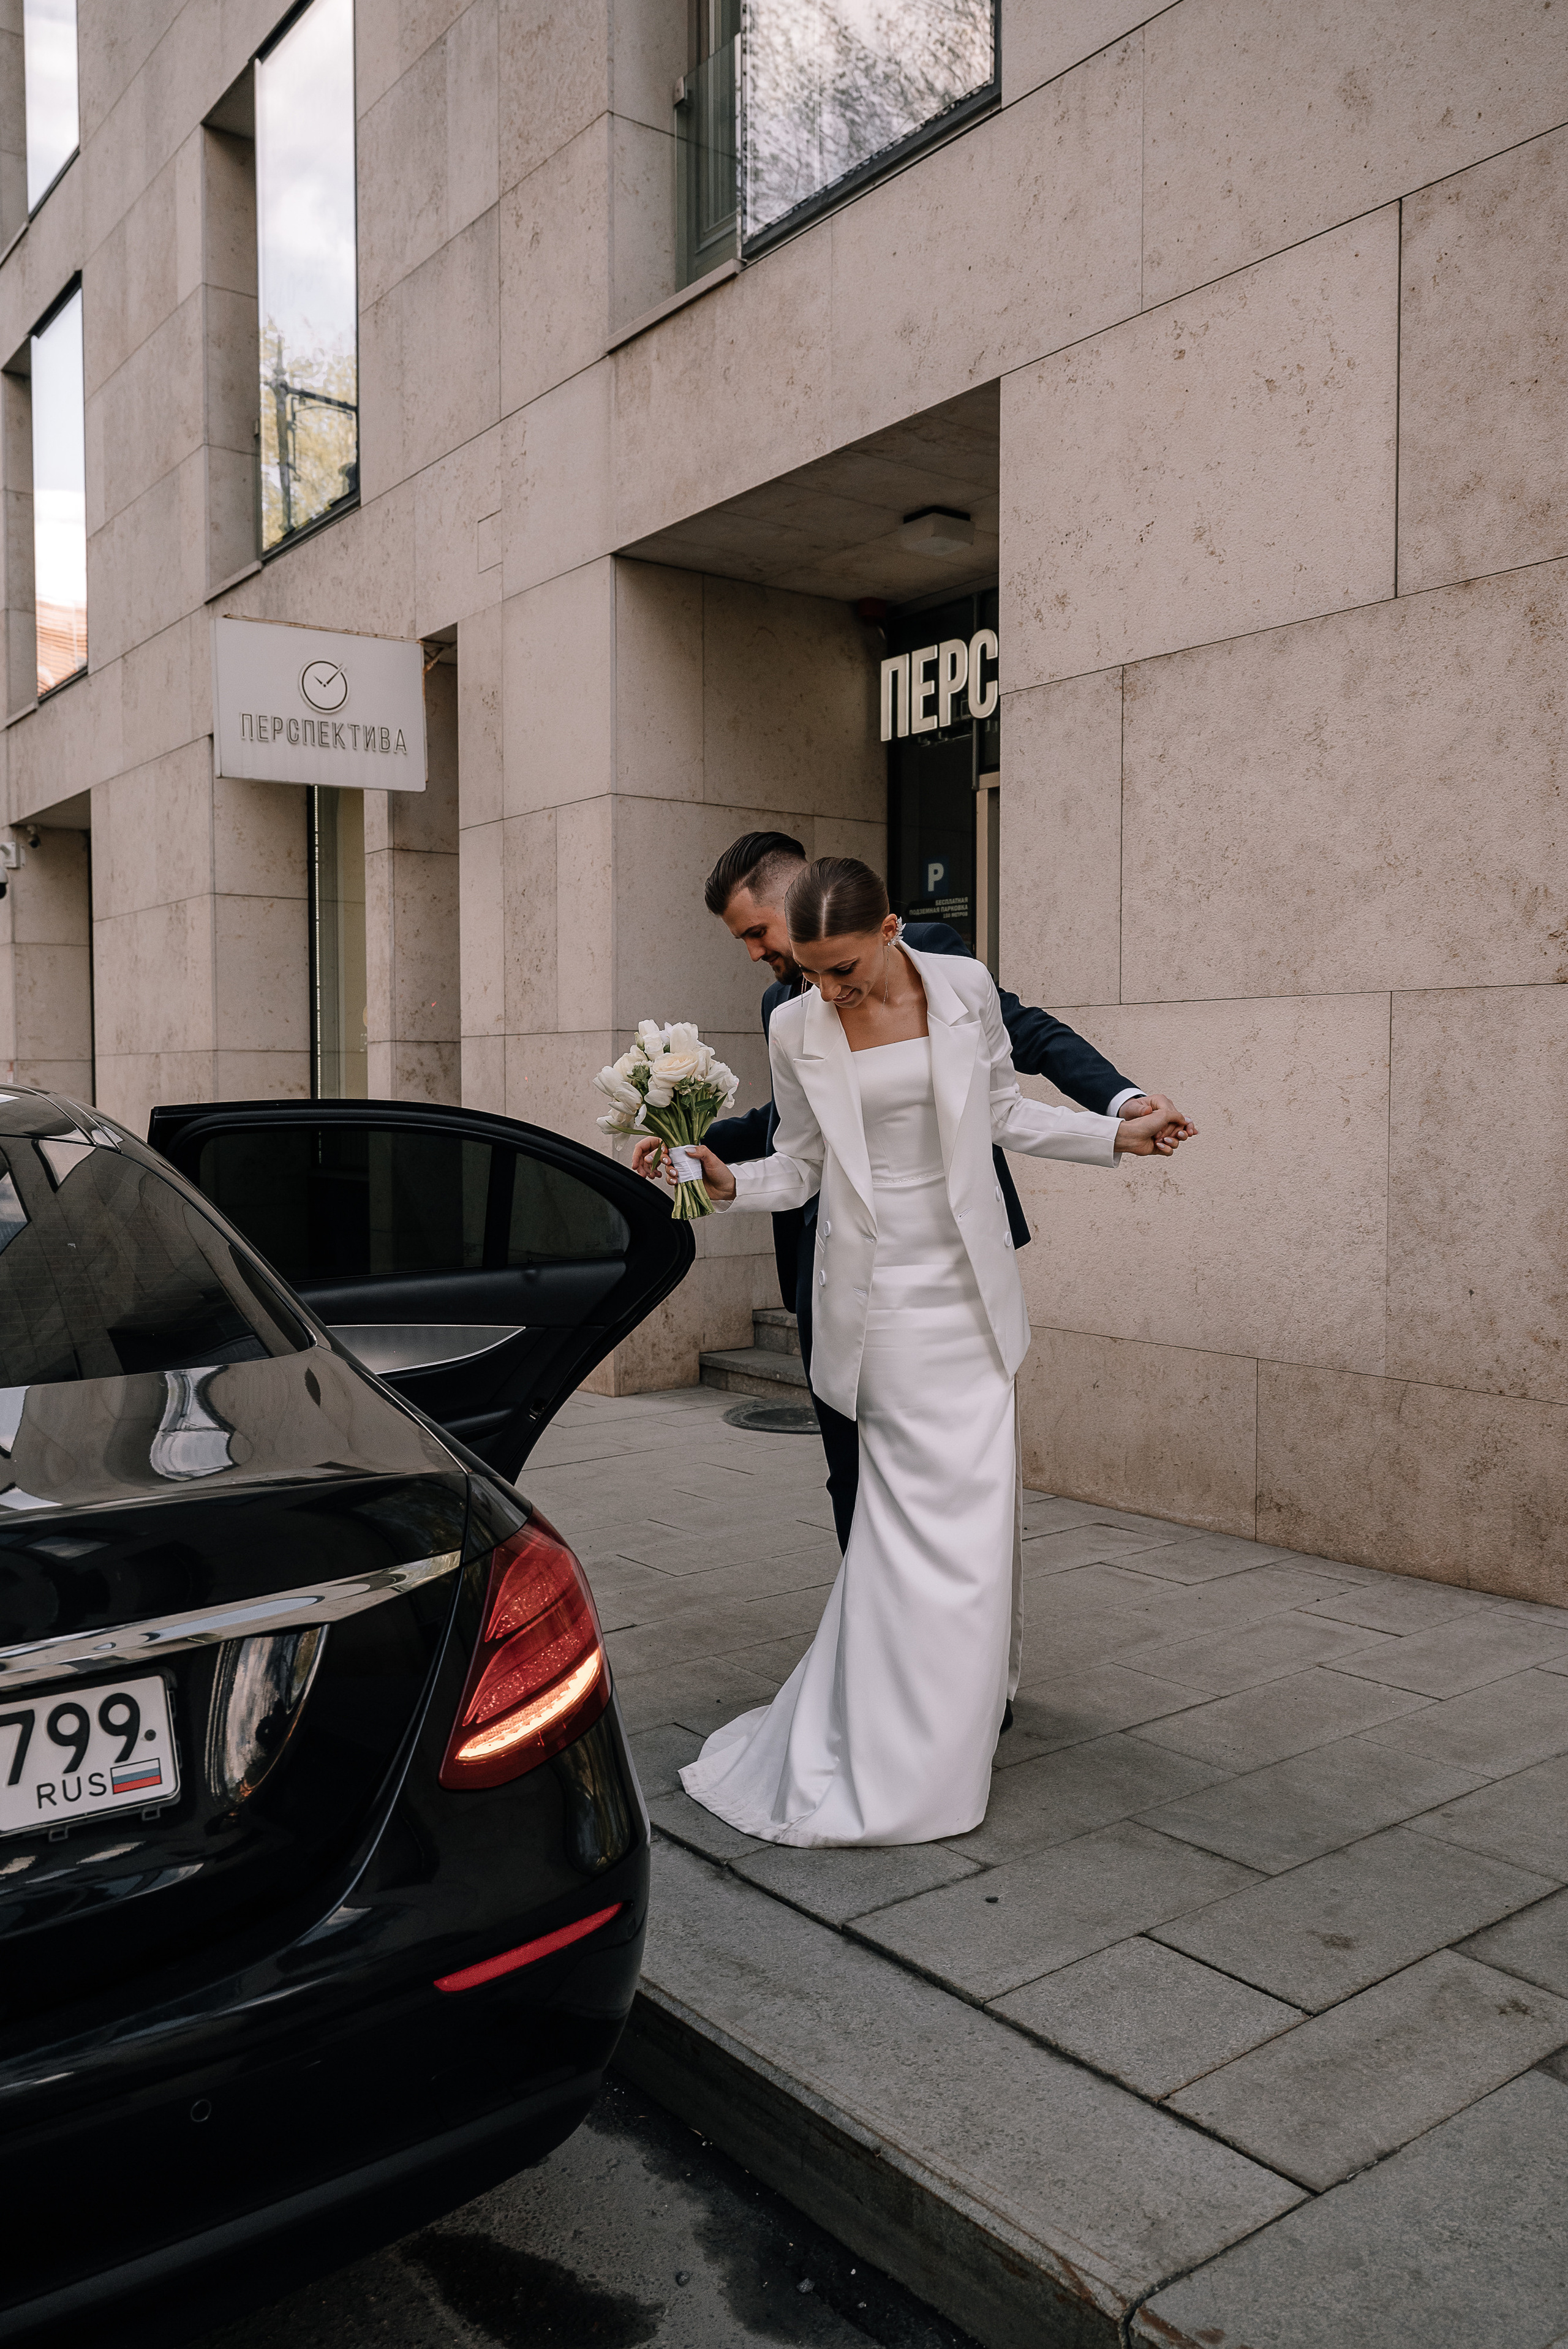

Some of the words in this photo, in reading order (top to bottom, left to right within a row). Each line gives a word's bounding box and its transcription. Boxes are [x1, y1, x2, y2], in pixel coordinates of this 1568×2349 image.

[881, 628, 998, 742] ПЕРС
[240, 712, 407, 755] ПЕРСПЕКТИВА
[935, 897, 968, 906] БЕСПЛАТНАЯ
[940, 904, 968, 913] ПАРКОВКА
[37, 1773, 107, 1809] RUS
